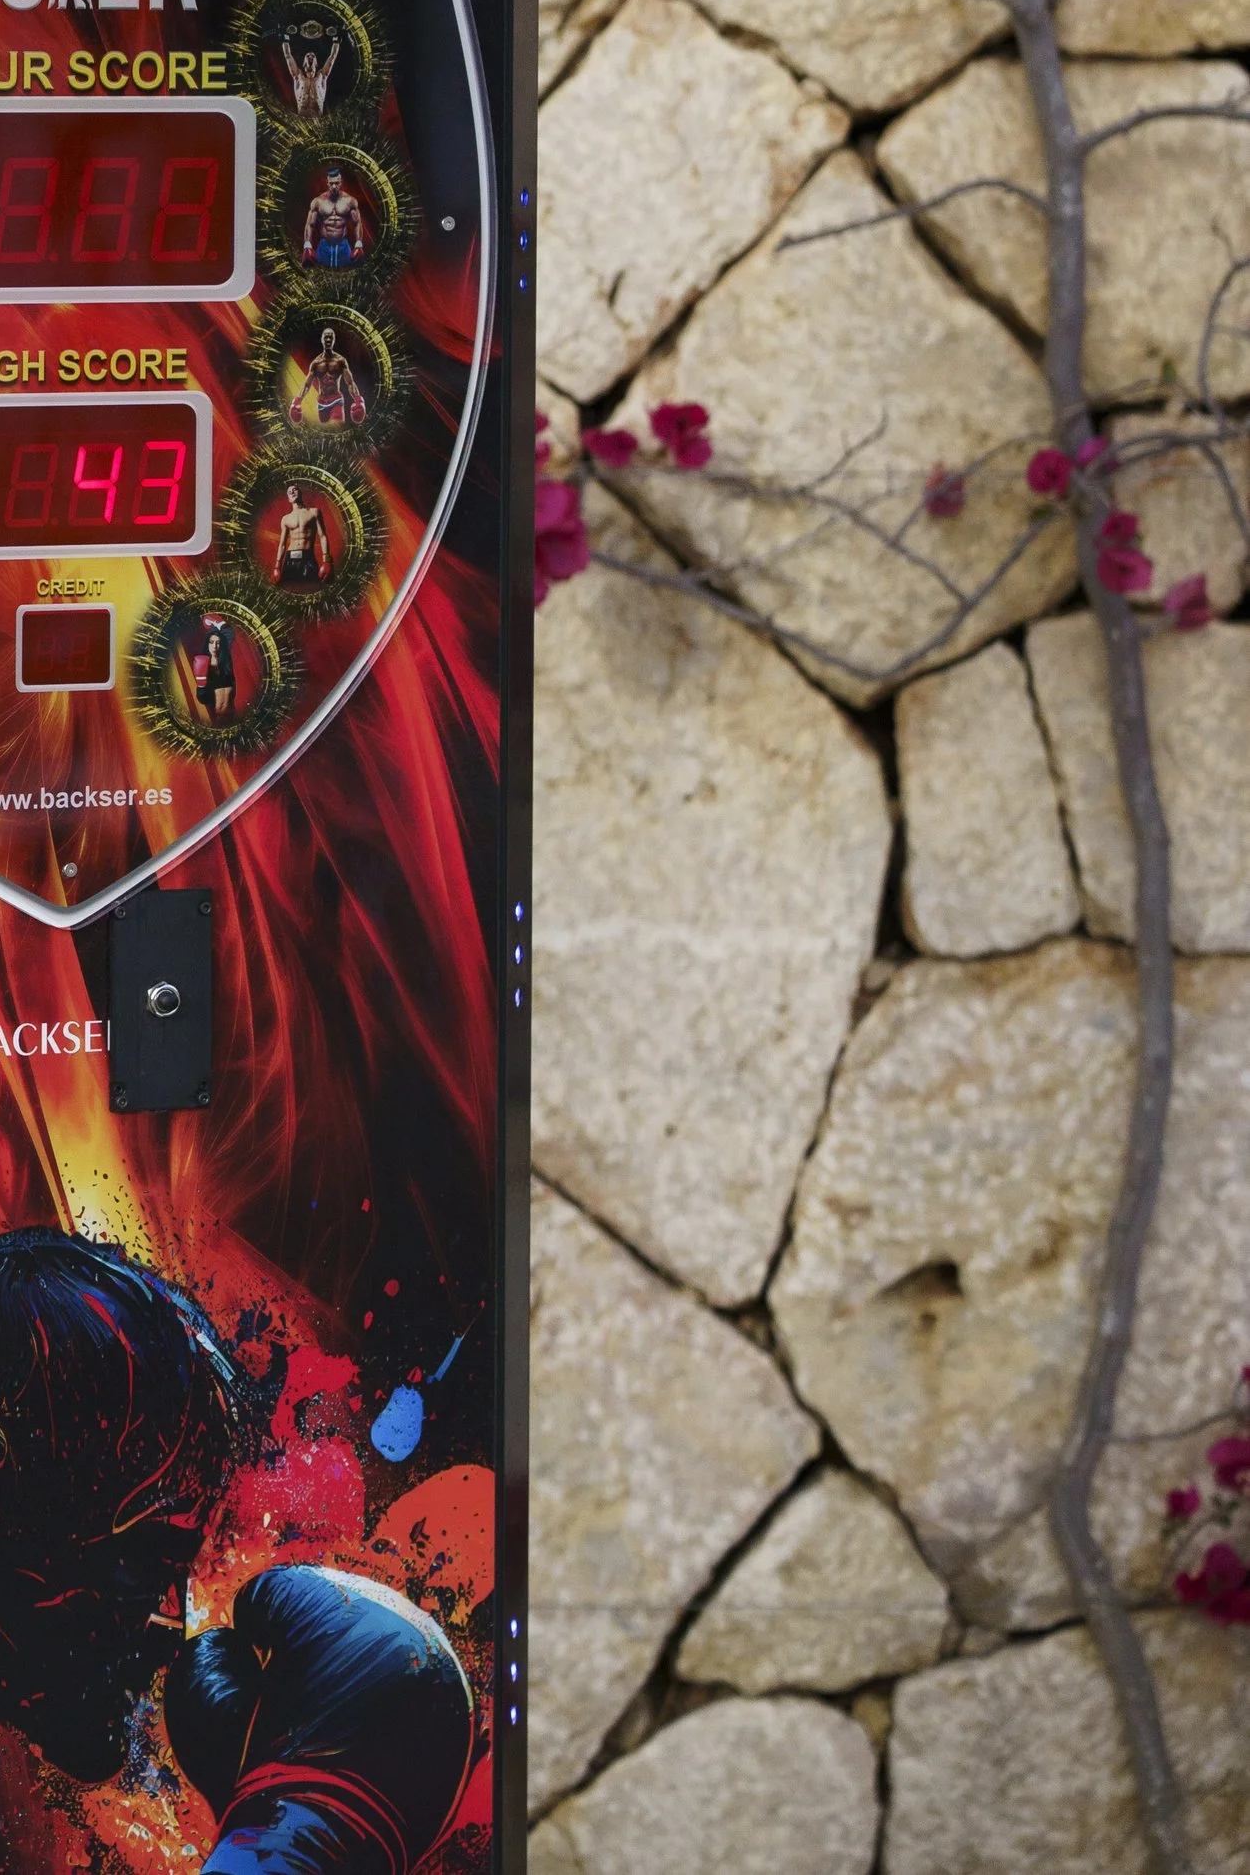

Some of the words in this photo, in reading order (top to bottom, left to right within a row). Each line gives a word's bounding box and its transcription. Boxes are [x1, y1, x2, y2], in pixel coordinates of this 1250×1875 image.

[68, 51, 228, 91] SCORE
[57, 348, 188, 382] SCORE
[73, 440, 187, 525] 43
[35, 578, 105, 596] CREDIT
